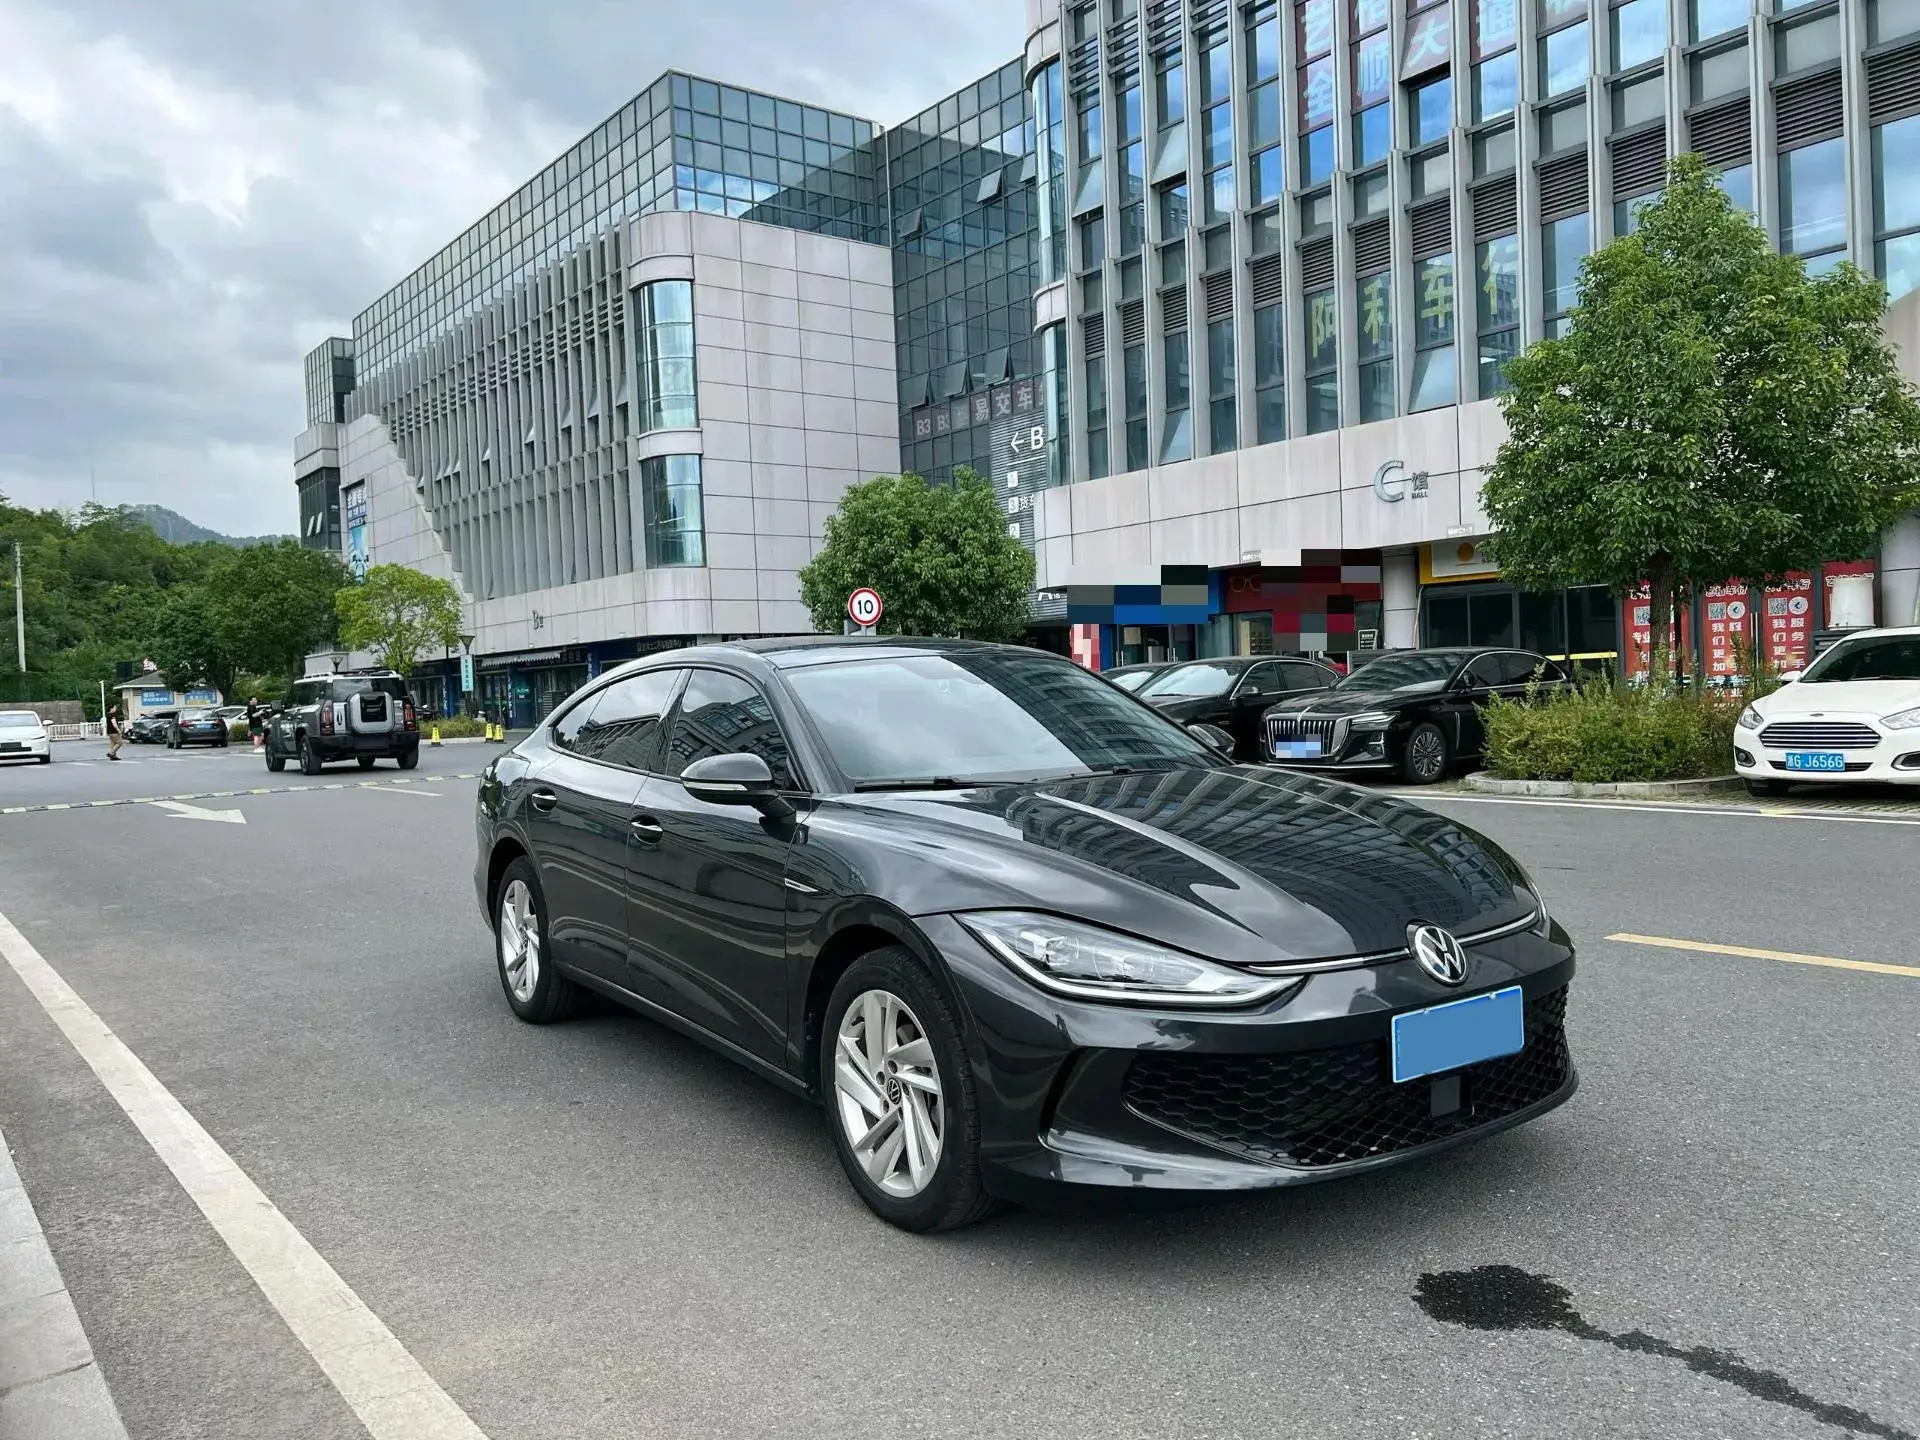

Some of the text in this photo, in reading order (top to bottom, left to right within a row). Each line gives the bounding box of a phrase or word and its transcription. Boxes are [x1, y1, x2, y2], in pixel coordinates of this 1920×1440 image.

[1030, 426, 1044, 450] B
[1374, 460, 1429, 502] C 馆
[1411, 491, 1429, 499] HALL
[858, 600, 873, 614] 10
[1790, 618, 1806, 669] 服务二手
